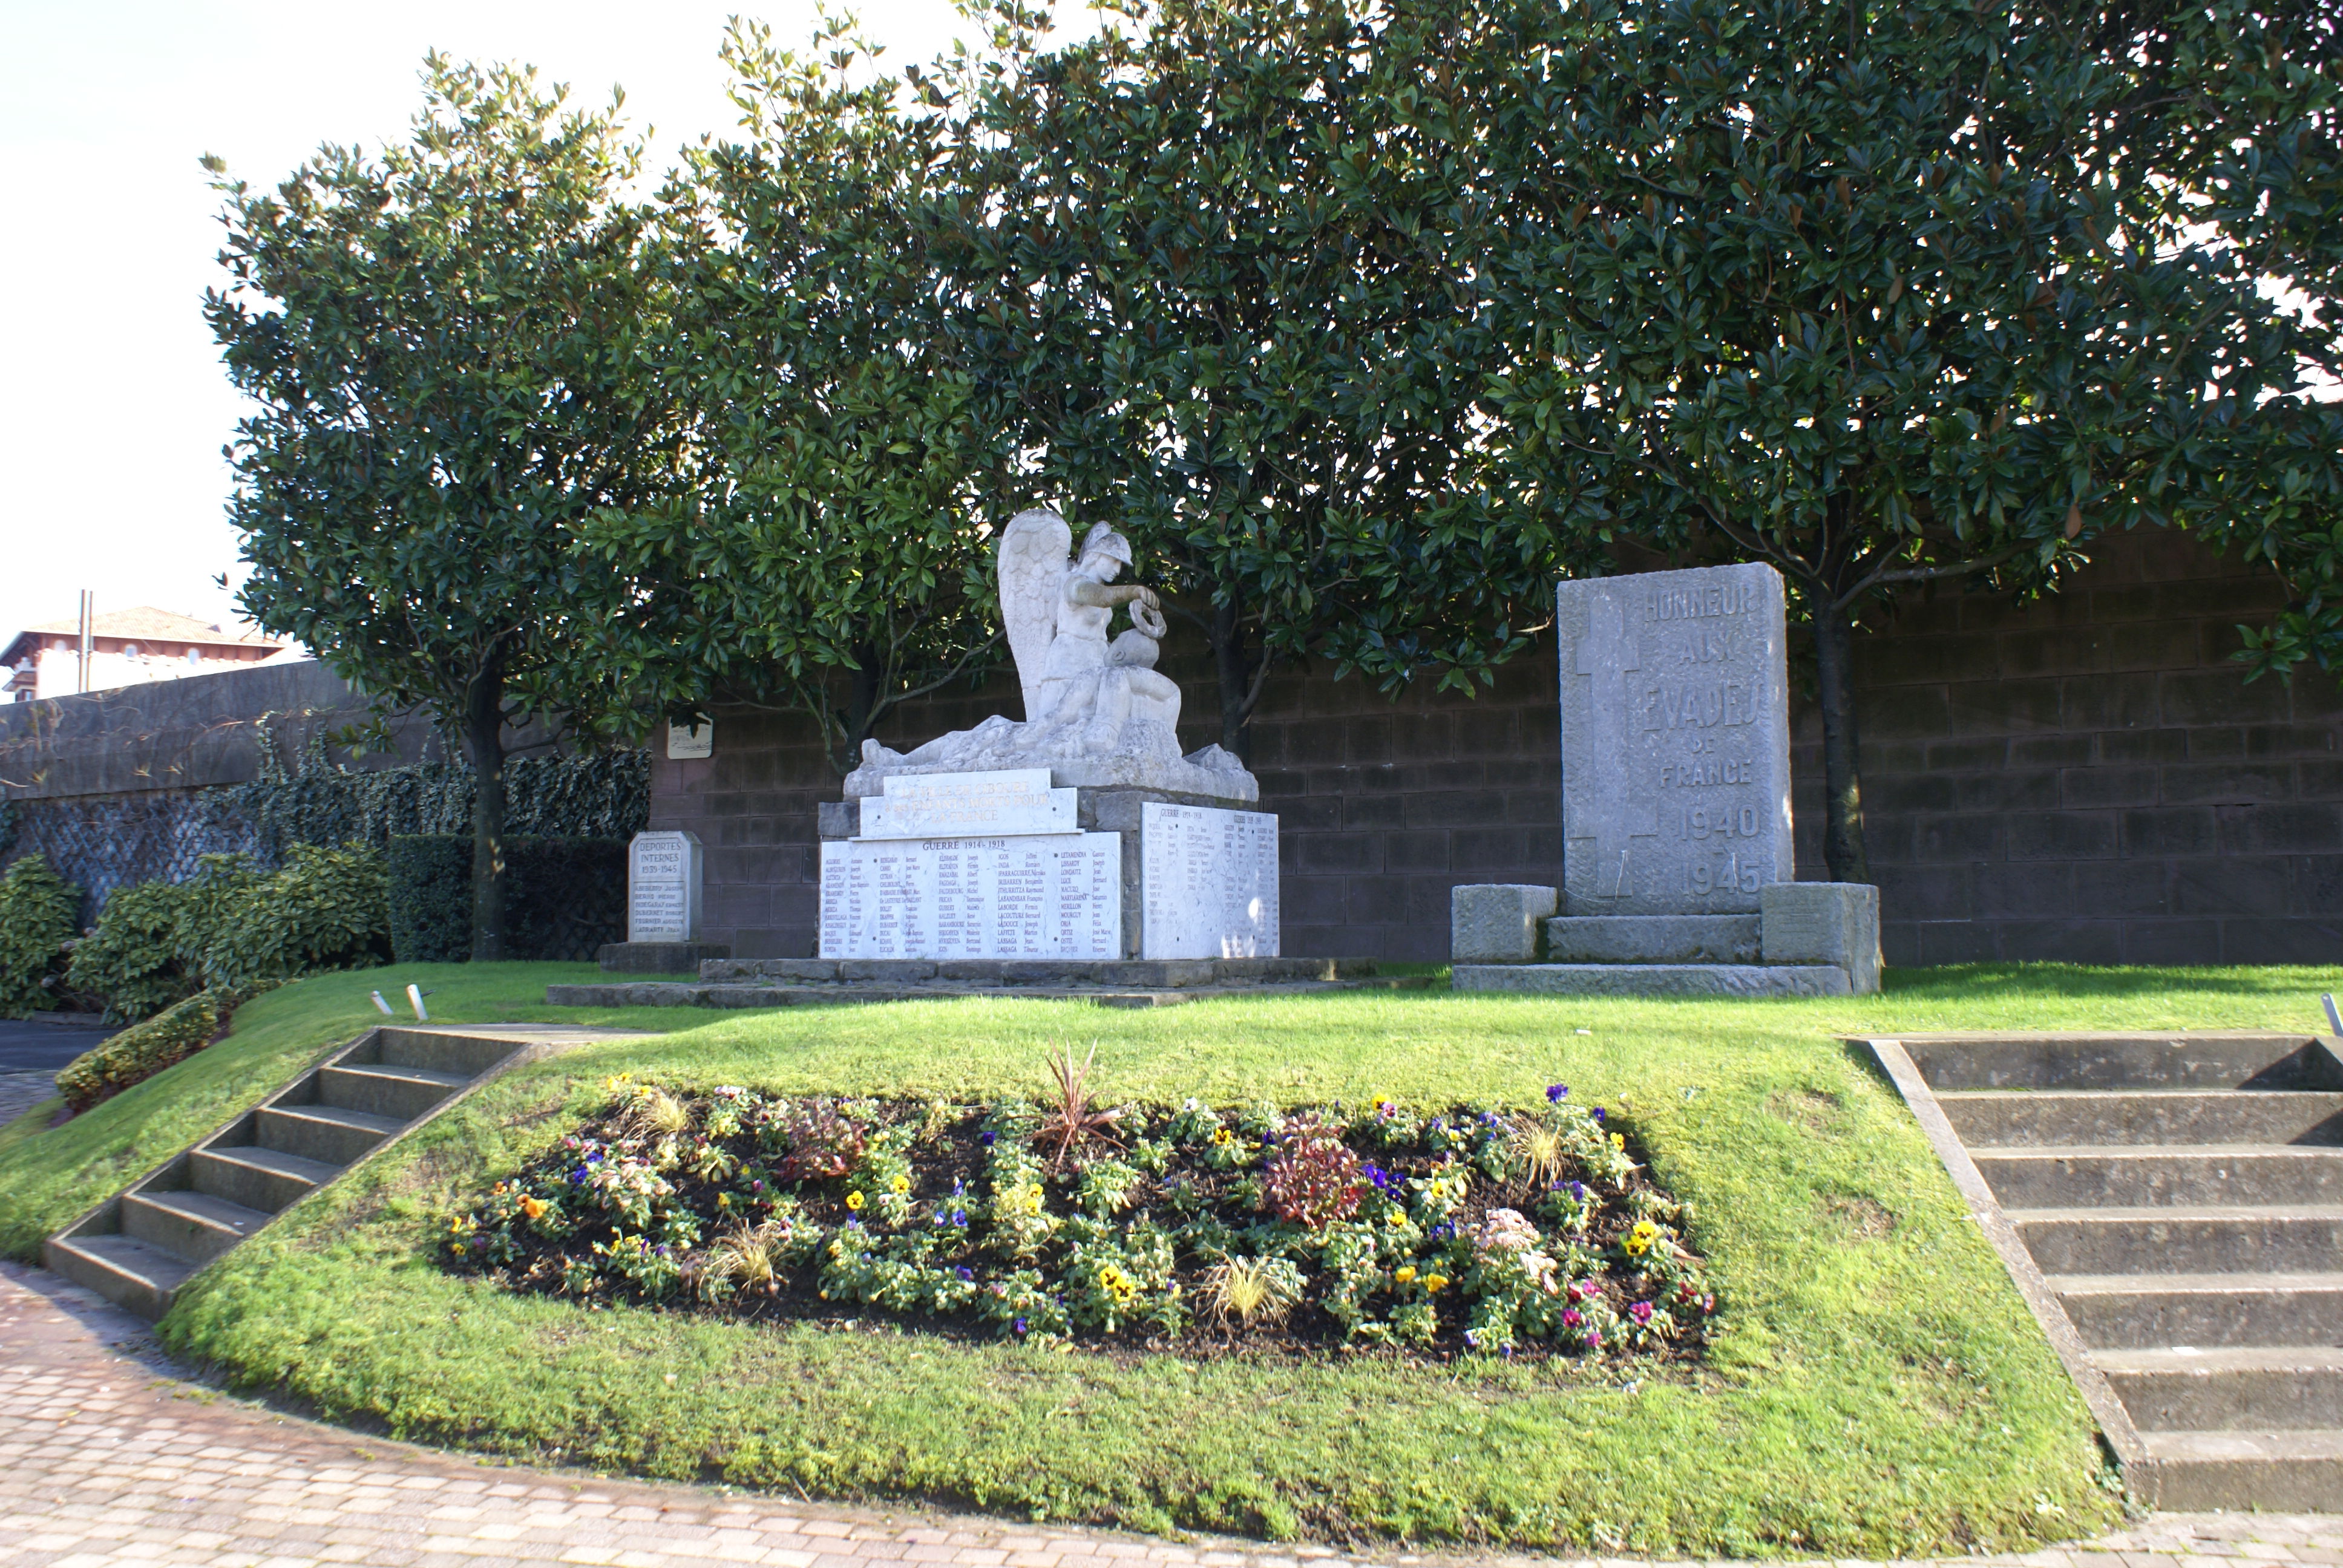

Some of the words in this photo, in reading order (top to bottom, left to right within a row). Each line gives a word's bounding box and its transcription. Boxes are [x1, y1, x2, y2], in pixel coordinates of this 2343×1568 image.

[1644, 584, 1759, 622] HONNEUR
[1680, 630, 1735, 665] AUX
[1692, 736, 1715, 754] DE
[1660, 759, 1752, 788] FRANCE
[902, 789, 916, 799] LA
[920, 785, 951, 797] VILLE
[956, 784, 971, 795] DE
[975, 782, 1029, 794] CIBOURE
[913, 799, 965, 811] ENFANTS
[969, 797, 1009, 808] MORTS
[1014, 794, 1048, 806] POUR
[932, 813, 946, 823] LA
[951, 810, 997, 823] FRANCE
[1161, 809, 1179, 817] GUERRE
[1680, 805, 1760, 840] 1940
[640, 843, 681, 851] DEPORTES
[923, 841, 959, 851] GUERRE
[641, 854, 679, 863] INTERNES
[1681, 858, 1761, 895] 1945
